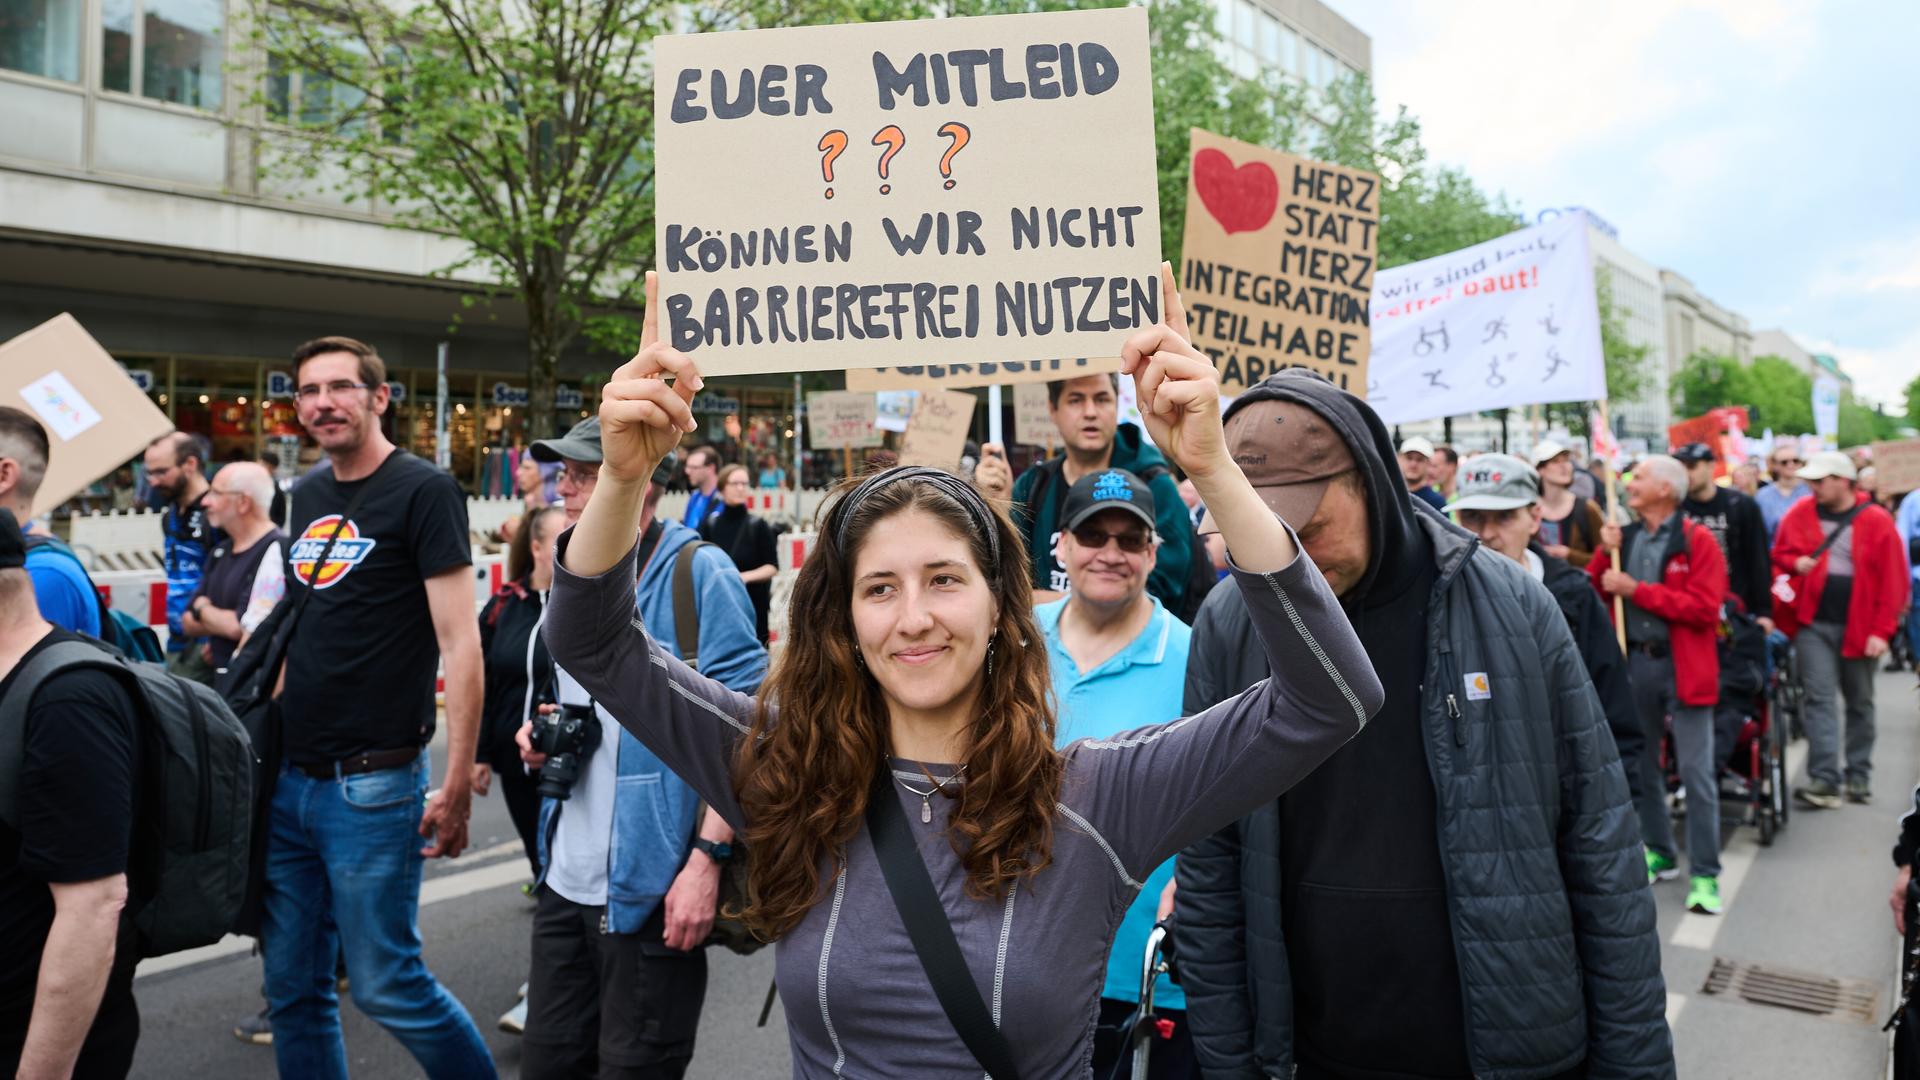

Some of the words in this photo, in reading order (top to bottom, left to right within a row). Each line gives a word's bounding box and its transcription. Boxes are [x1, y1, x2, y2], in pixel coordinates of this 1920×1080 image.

[671, 64, 833, 123] EUER
[873, 43, 1119, 110] MITLEID
[1292, 165, 1375, 213] HERZ
[666, 221, 852, 272] KÖNNEN
[882, 211, 986, 256] WIR
[1011, 206, 1144, 249] NICHT
[1284, 204, 1377, 250] STATT
[1185, 259, 1370, 327] INTEGRATION
[1280, 241, 1372, 292] MERZ
[666, 282, 979, 352] BARRIEREFREI
[996, 276, 1158, 337] NUTZEN
